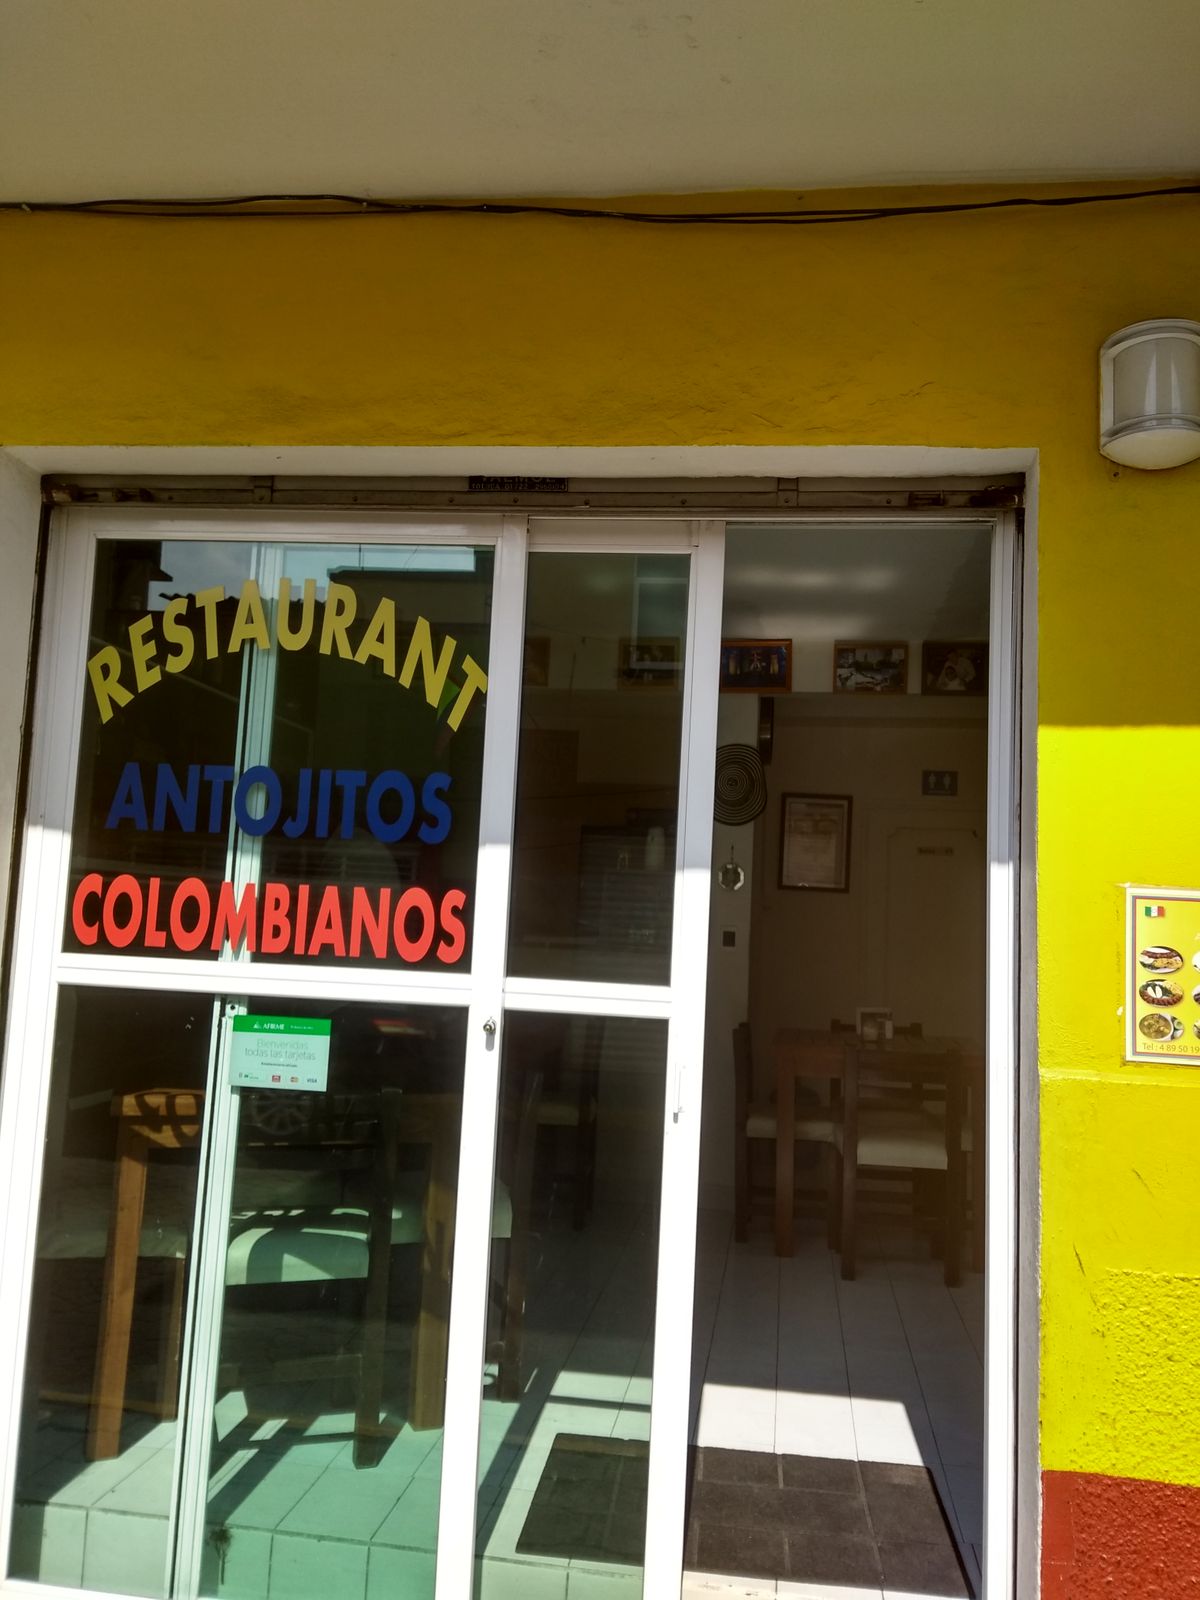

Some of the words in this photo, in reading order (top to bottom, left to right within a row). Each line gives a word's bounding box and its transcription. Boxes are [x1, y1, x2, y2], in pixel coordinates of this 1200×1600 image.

[87, 578, 488, 732] RESTAURANT
[105, 762, 453, 845] ANTOJITOS
[72, 873, 467, 964] COLOMBIANOS
[285, 1050, 317, 1062] tarjetas
